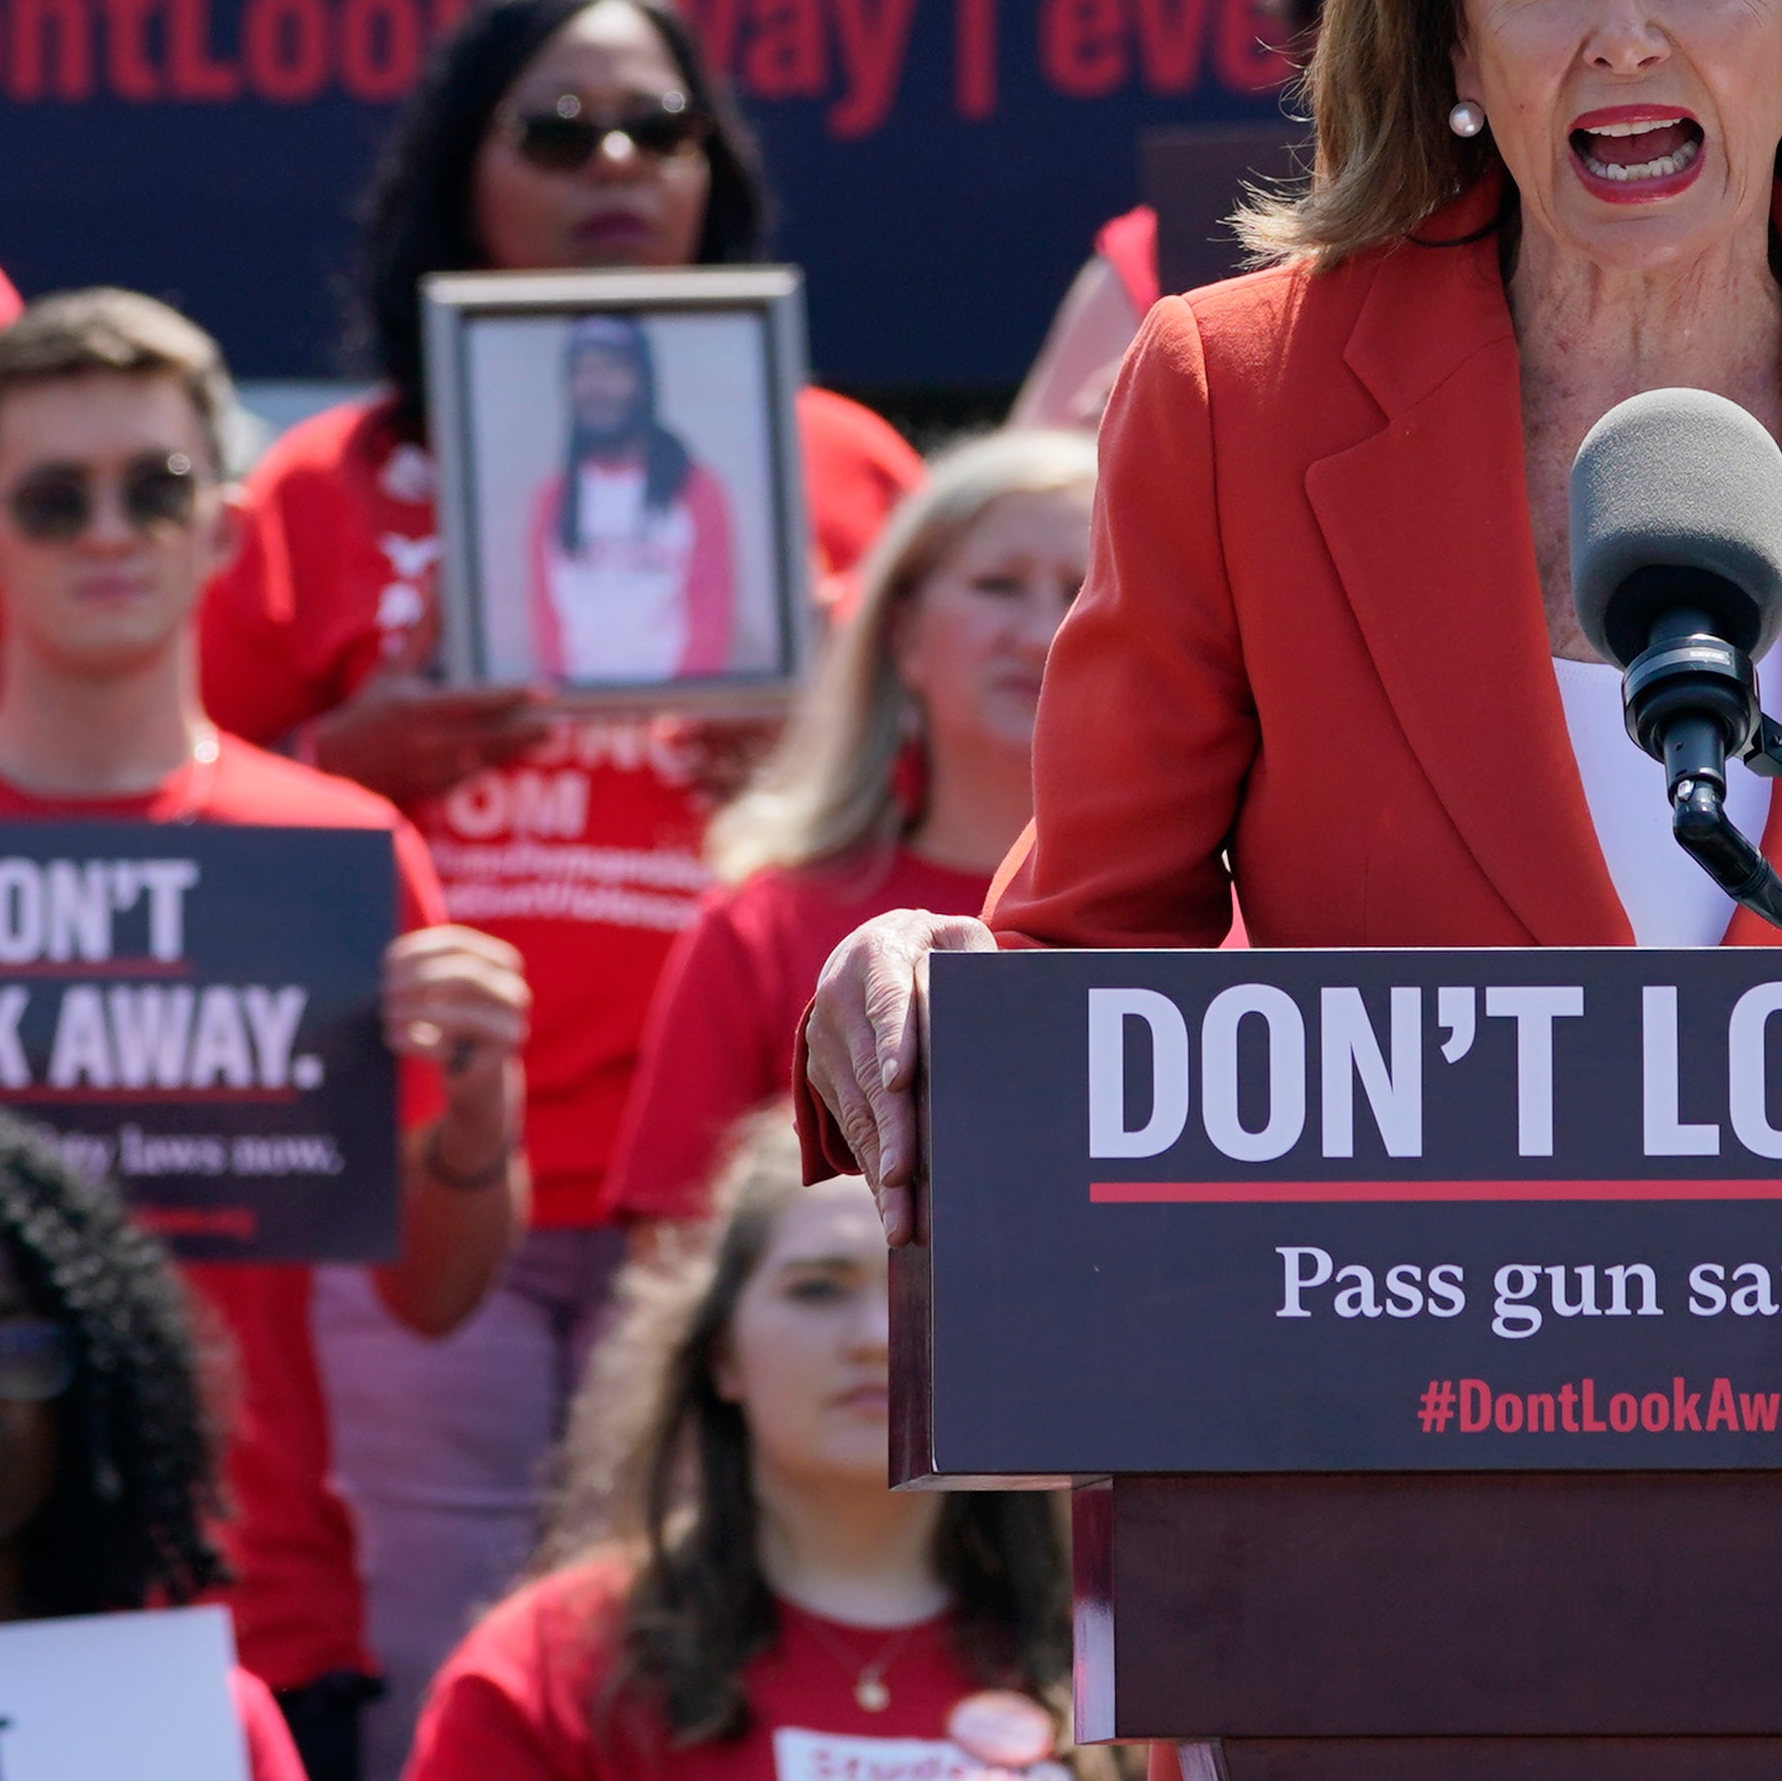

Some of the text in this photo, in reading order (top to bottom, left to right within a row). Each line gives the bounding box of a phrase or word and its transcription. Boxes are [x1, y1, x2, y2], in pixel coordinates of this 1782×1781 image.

[48, 985, 324, 1089] AWAY.
[1088, 983, 1584, 1162] DON'T
[1276, 1247, 1465, 1318] Pass
[1491, 1264, 1663, 1339] gun
